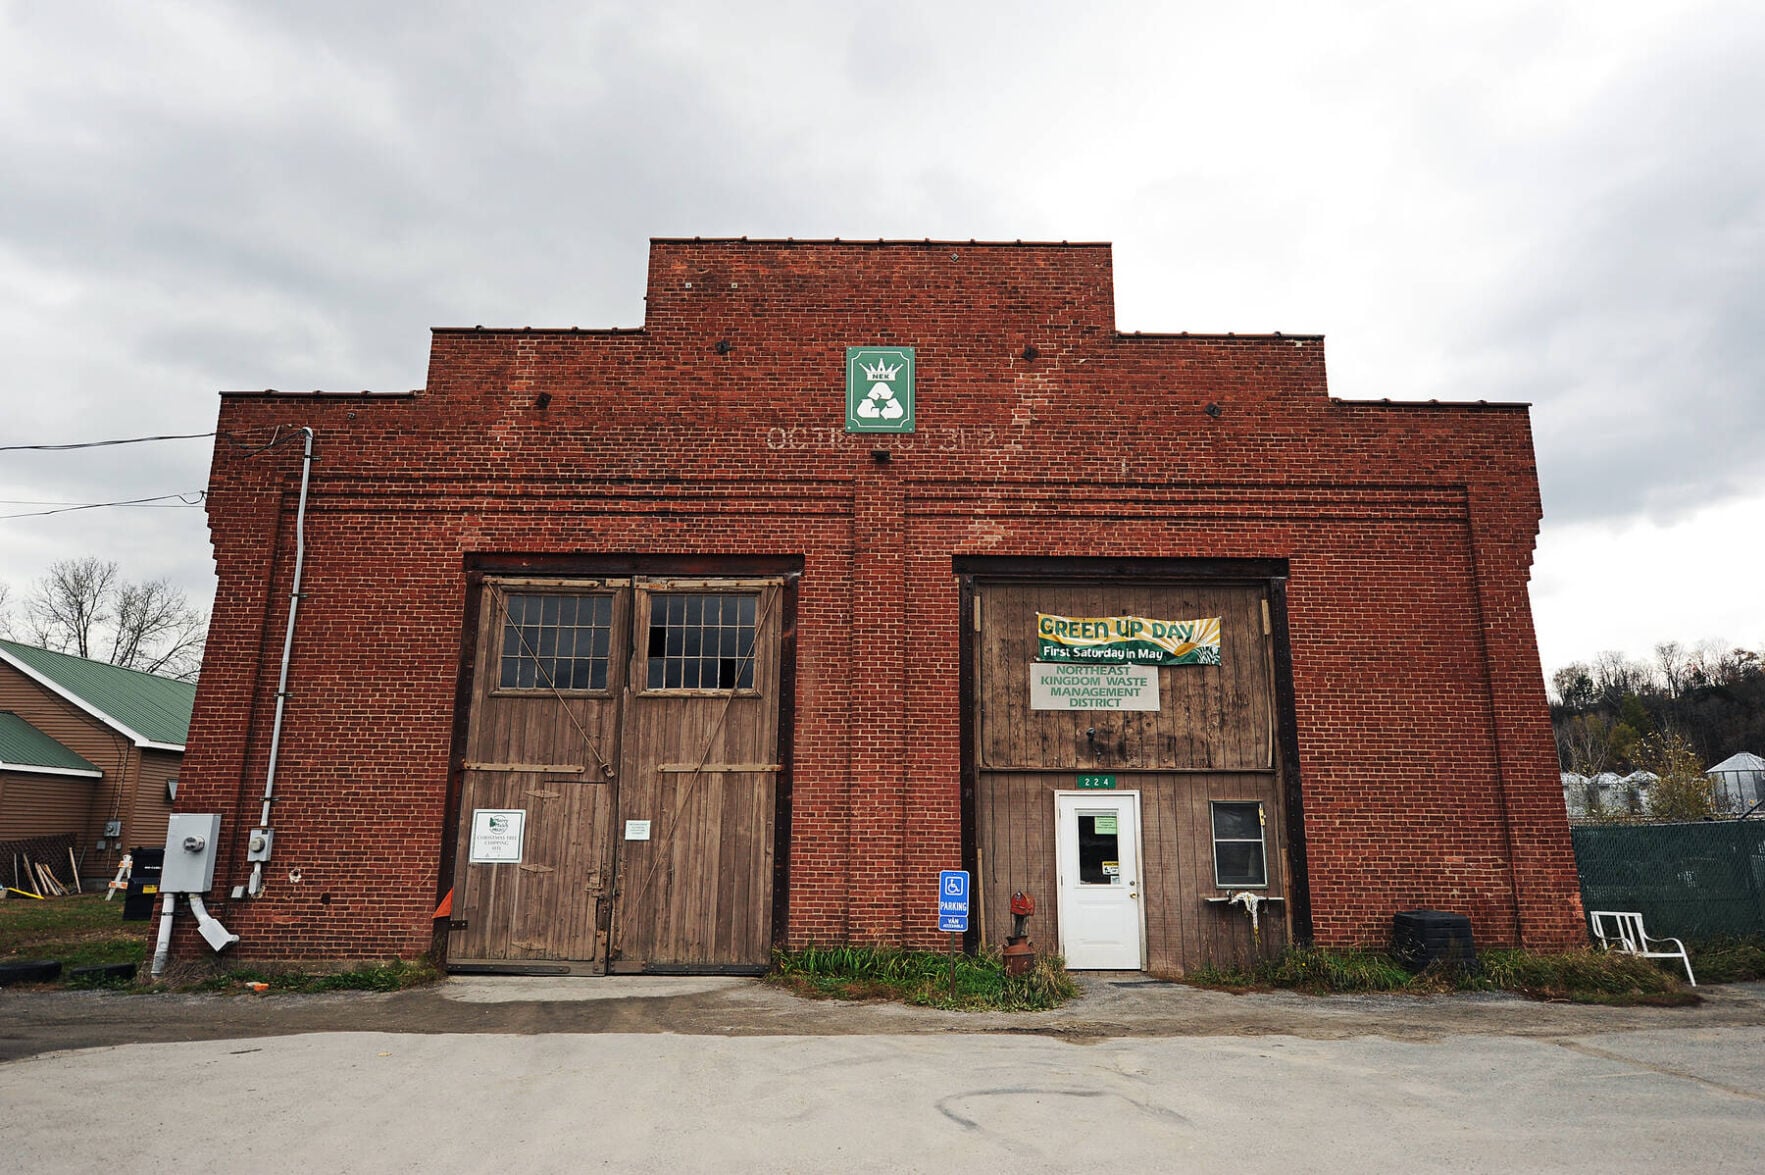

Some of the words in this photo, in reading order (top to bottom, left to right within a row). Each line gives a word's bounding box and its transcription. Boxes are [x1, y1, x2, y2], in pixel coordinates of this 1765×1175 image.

[1040, 617, 1109, 639] GREEN
[1116, 619, 1144, 638] UP
[1151, 622, 1195, 643] DAY
[1043, 645, 1071, 657] First
[1074, 646, 1125, 661] Saturday
[1126, 648, 1136, 659] in
[1138, 648, 1163, 661] May
[1056, 665, 1131, 676] NORTHEAST
[1041, 676, 1101, 686] KINGDOM
[1106, 677, 1148, 687] WASTE
[1050, 687, 1141, 697] MANAGEMENT
[1069, 697, 1122, 708] DISTRICT
[940, 901, 967, 911] PARKING
